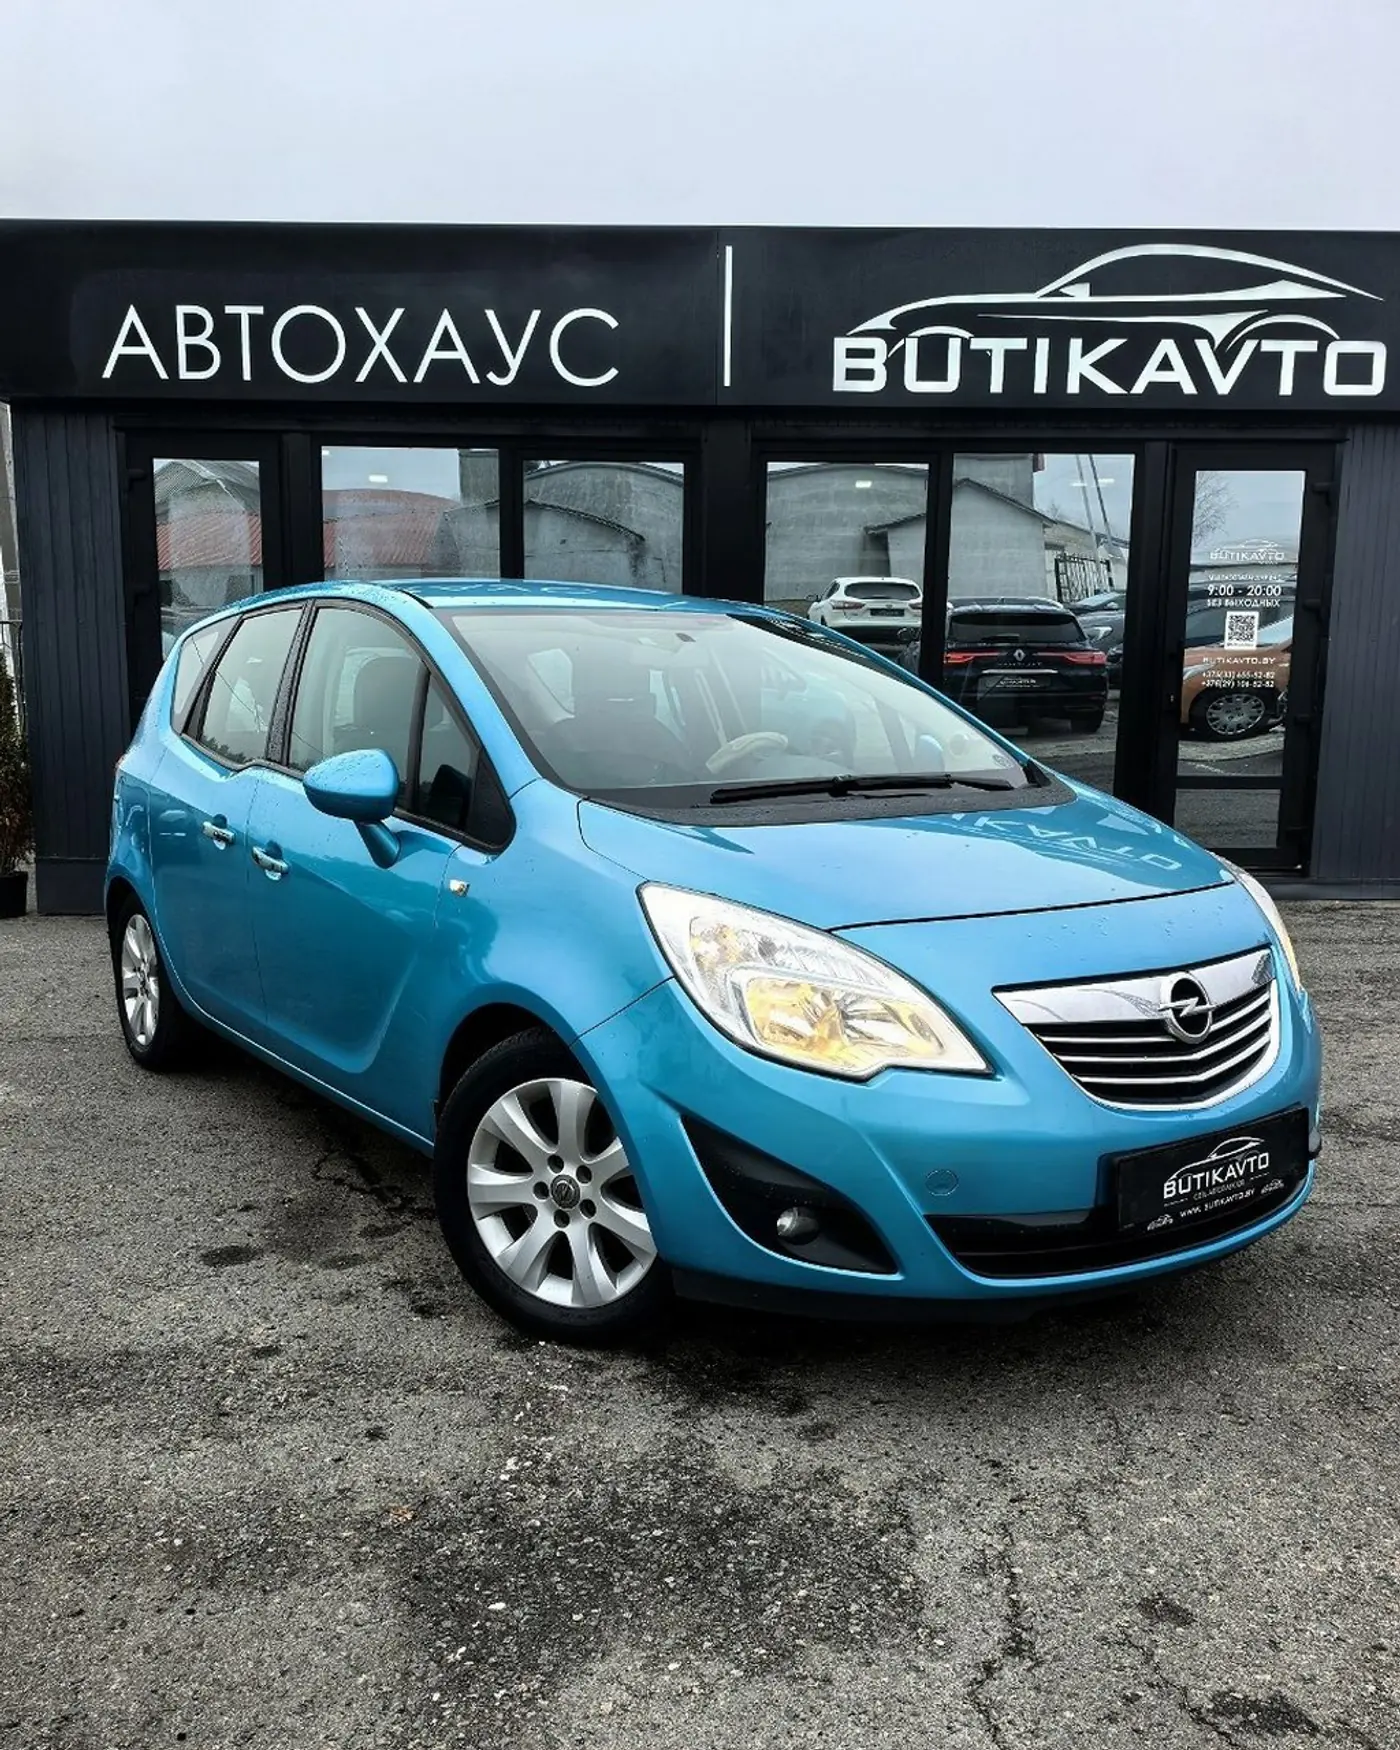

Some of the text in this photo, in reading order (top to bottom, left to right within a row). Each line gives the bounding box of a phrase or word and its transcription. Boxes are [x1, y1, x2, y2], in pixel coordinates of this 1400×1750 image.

[102, 303, 619, 387] АВТОХАУС
[832, 336, 1387, 397] BUTIKAVTO
[1209, 551, 1285, 561] BUTIKAVTO
[1207, 583, 1234, 596] 9:00
[1246, 584, 1282, 597] 20:00
[1163, 1152, 1270, 1200] BUTIKAVTO
